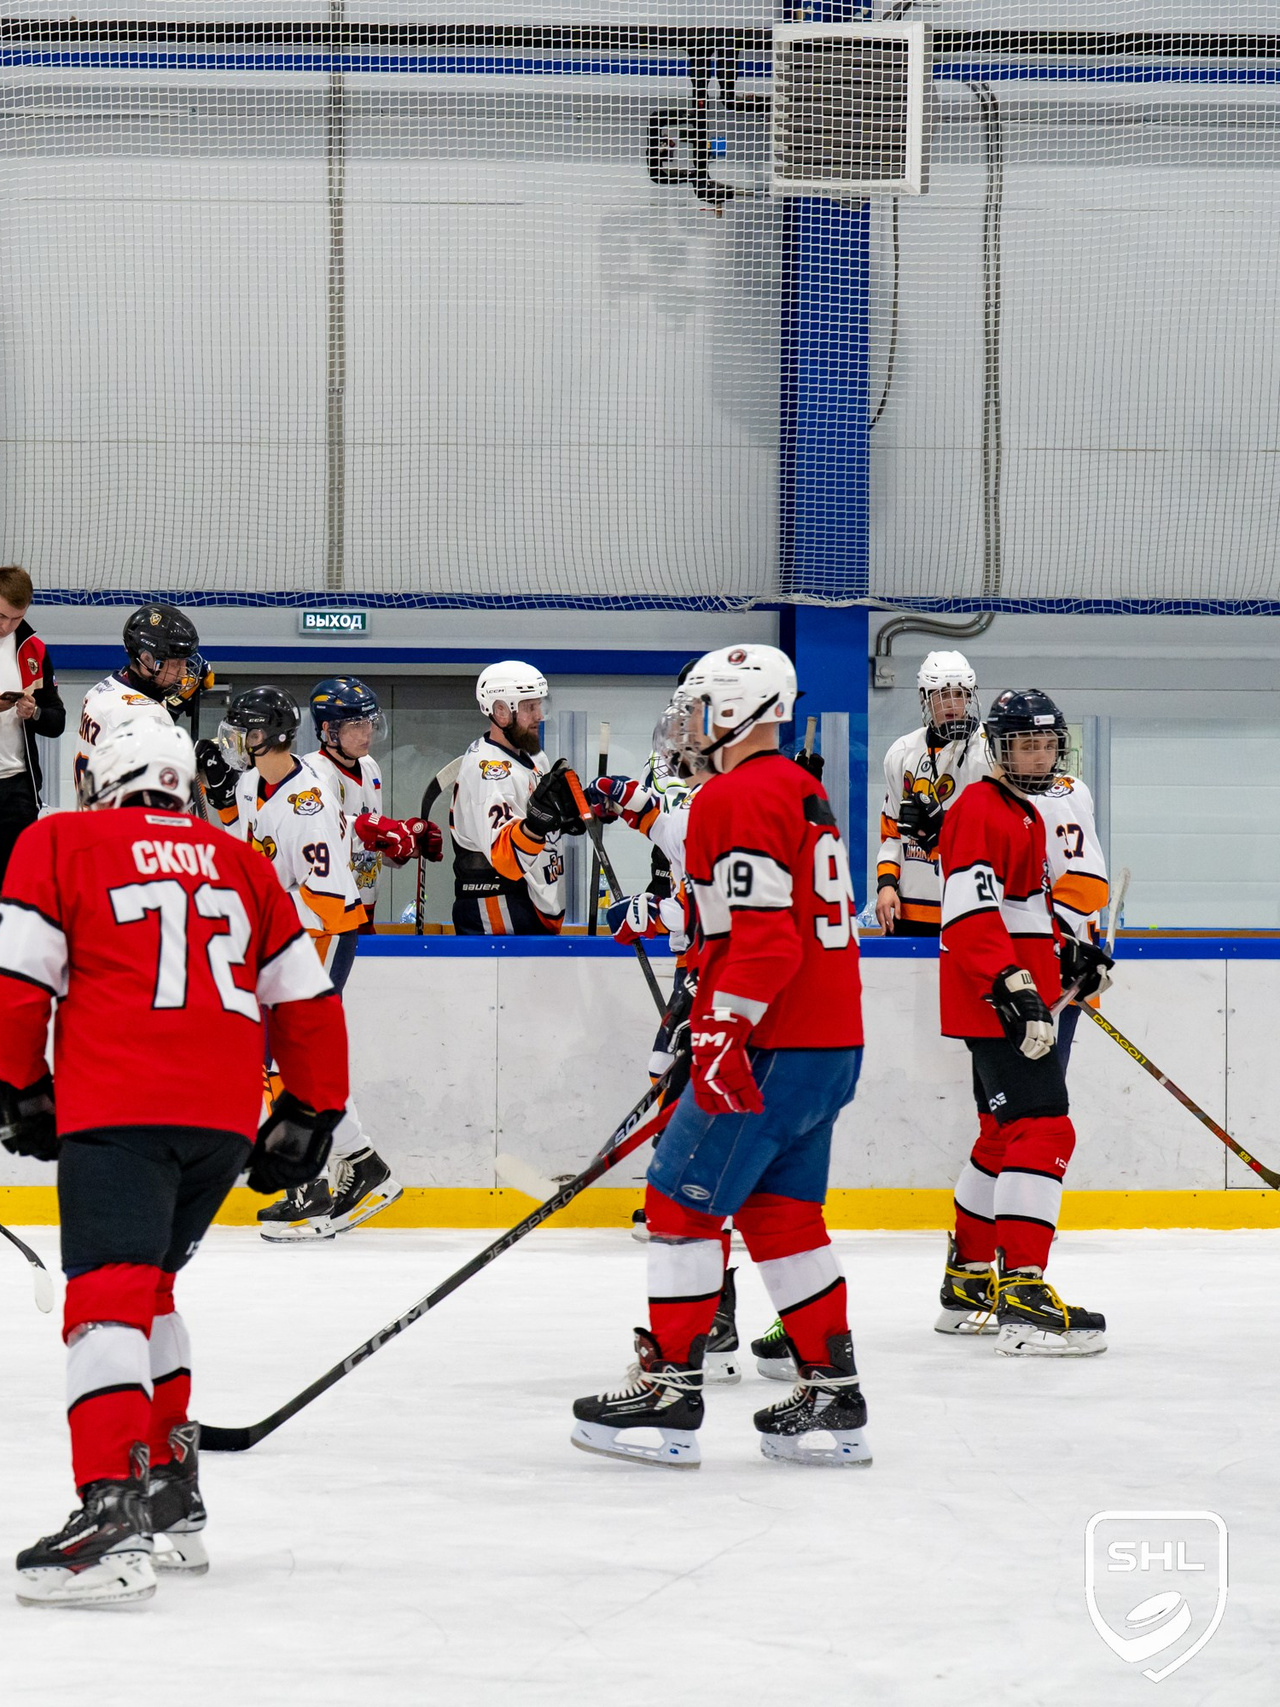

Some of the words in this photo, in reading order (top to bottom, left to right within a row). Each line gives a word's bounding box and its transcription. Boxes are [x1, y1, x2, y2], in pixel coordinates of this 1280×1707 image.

[306, 614, 362, 629] ВЫХОД
[131, 839, 220, 880] СКОК
[1055, 823, 1085, 860] 37
[462, 883, 501, 891] BAUER
[813, 831, 861, 950] 9
[107, 879, 261, 1024] 72
[1092, 1013, 1148, 1066] DRAGON
[482, 1189, 576, 1266] JETSPEED
[343, 1299, 430, 1374] CCM
